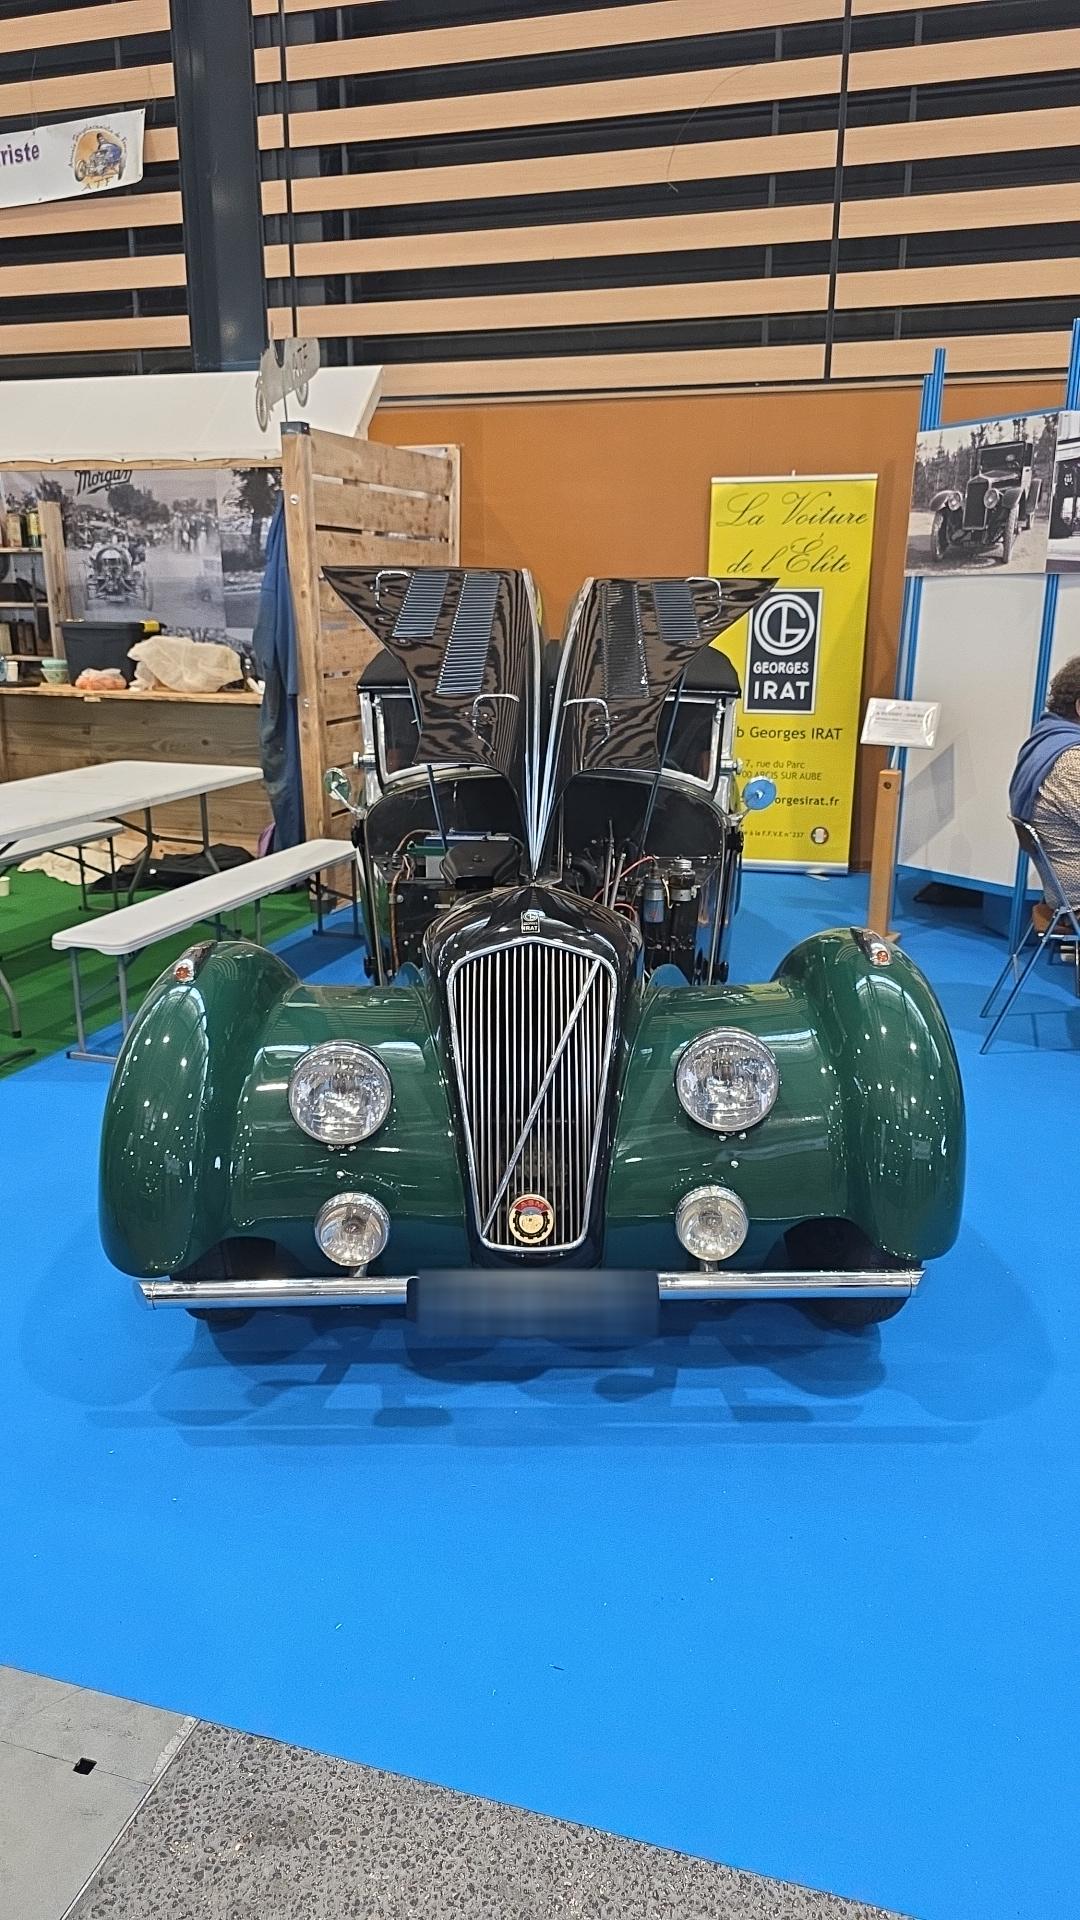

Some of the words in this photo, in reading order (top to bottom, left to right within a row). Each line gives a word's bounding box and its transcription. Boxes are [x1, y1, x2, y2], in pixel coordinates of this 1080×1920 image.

[75, 470, 133, 496] Morgan
[716, 492, 769, 527] La
[781, 491, 869, 526] Voiture
[727, 549, 754, 574] de
[753, 661, 809, 675] GEORGES
[753, 680, 810, 700] IRAT
[750, 726, 806, 742] Georges
[811, 728, 843, 740] IRAT
[756, 761, 771, 769] rue
[773, 760, 784, 769] du
[786, 760, 806, 770] Parc
[780, 772, 797, 781] SUR
[799, 772, 823, 782] AUBE
[774, 796, 840, 806] orgesirat.fr
